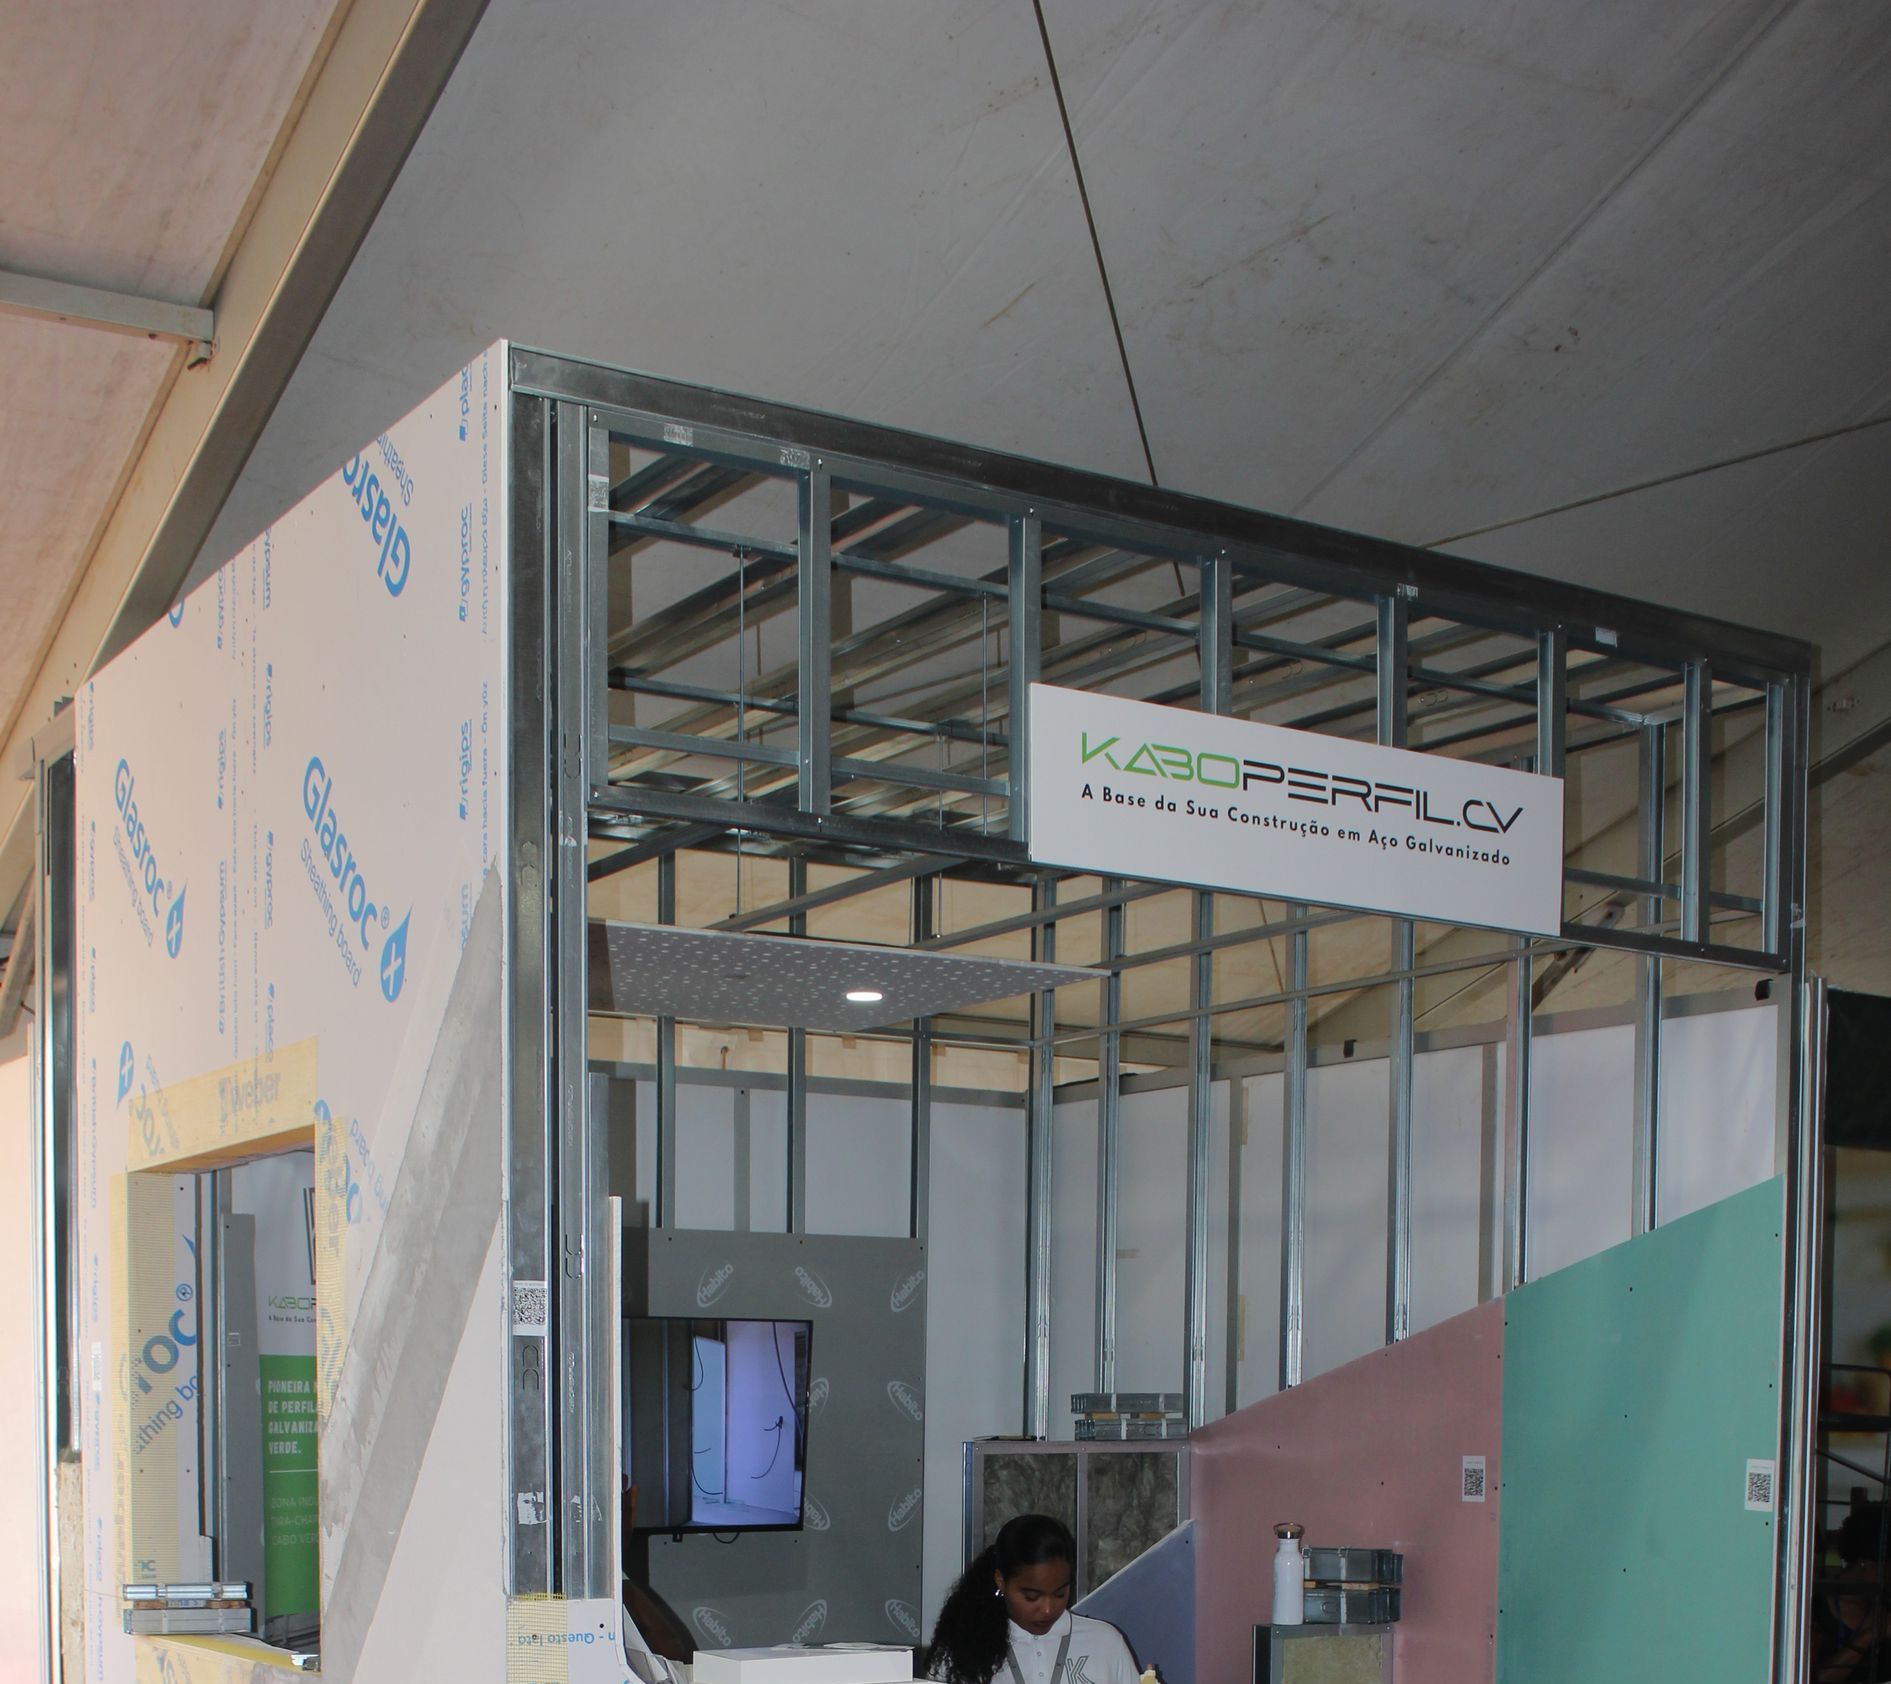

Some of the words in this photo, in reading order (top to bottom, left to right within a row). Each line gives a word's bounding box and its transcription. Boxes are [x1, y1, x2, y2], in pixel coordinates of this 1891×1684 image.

[1081, 731, 1524, 834] KABOPERFIL.CV
[115, 758, 165, 918] Glasroc
[1081, 783, 1094, 800] A
[1103, 786, 1146, 808] Base
[1155, 795, 1177, 812] da
[1186, 799, 1219, 819] Sua
[1228, 806, 1330, 838] Construção
[1338, 828, 1361, 842] em
[1368, 829, 1398, 851] Aço
[1406, 835, 1511, 866] Galvanizado
[303, 756, 379, 951] Glasroc
[699, 1263, 734, 1301] Habito
[795, 1266, 828, 1304] Habito
[893, 1269, 925, 1305] Habito
[268, 1401, 279, 1414] DE
[892, 1381, 923, 1421] Habito
[890, 1487, 923, 1526] Habito
[547, 1631, 595, 1645] Questo
[698, 1608, 733, 1647] Habito
[792, 1601, 826, 1643] Habito
[889, 1599, 922, 1638] Habito
